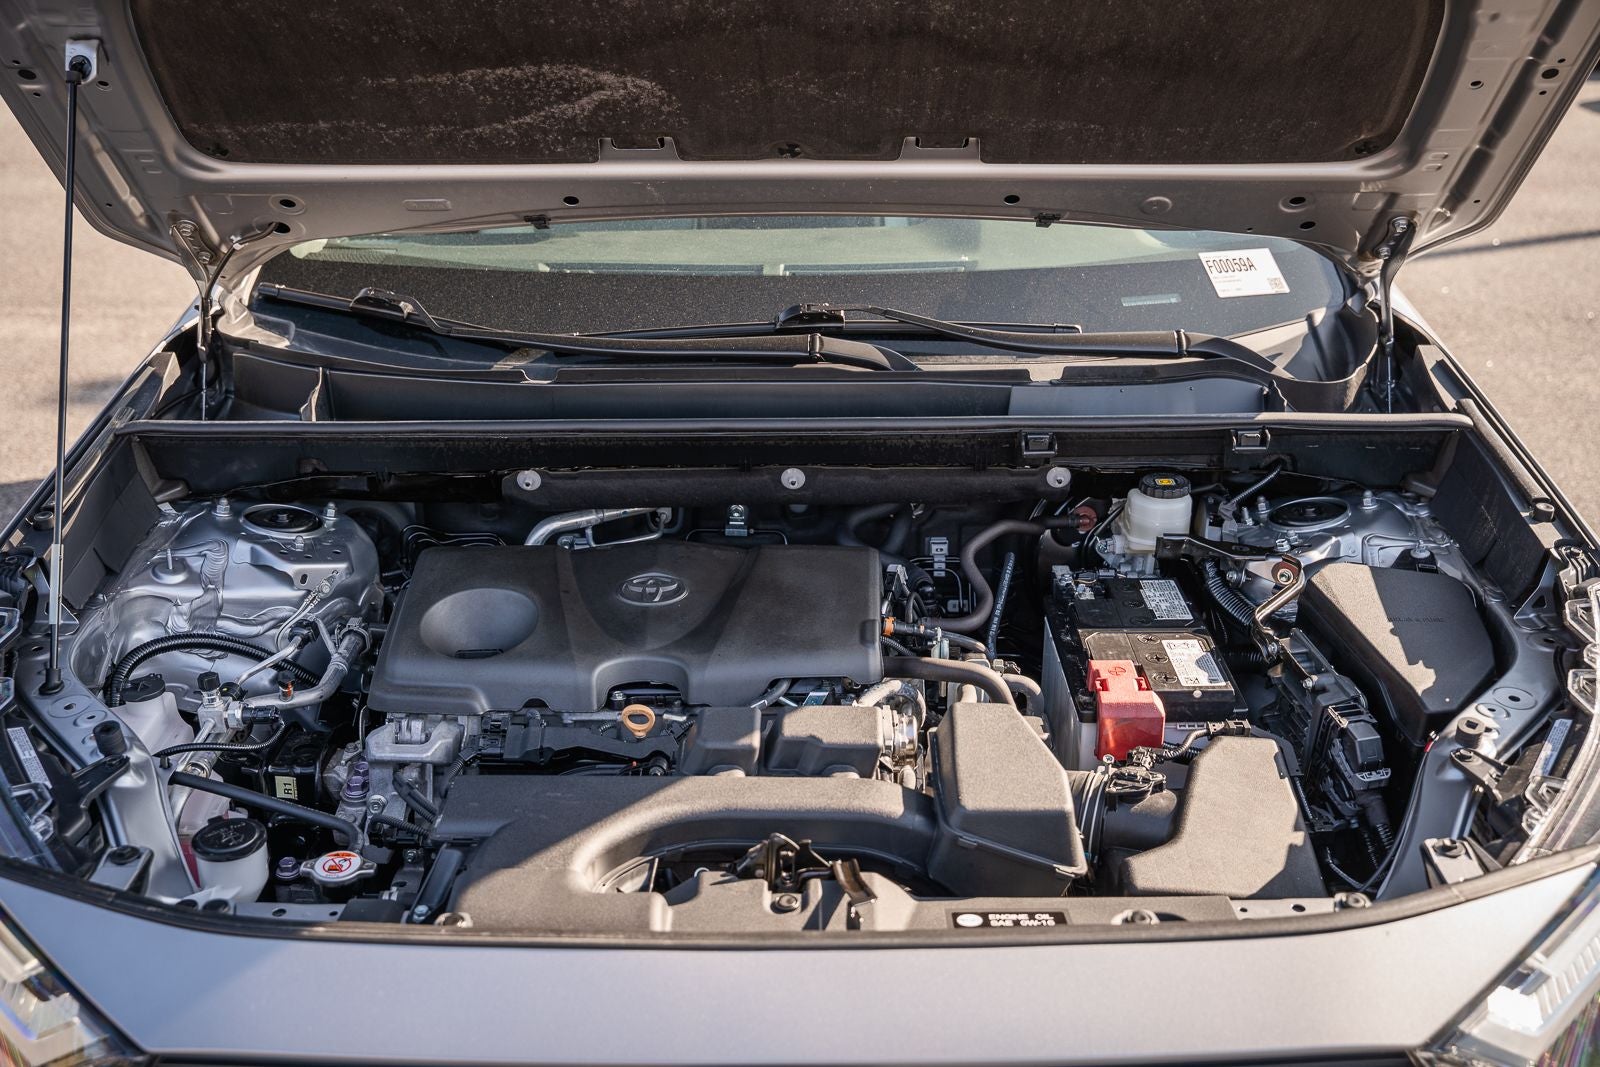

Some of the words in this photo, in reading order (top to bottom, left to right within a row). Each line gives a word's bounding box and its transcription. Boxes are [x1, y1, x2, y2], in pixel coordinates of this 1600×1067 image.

[1205, 257, 1258, 274] F00059A
[283, 782, 293, 795] R1
[990, 919, 1014, 927] SAE
